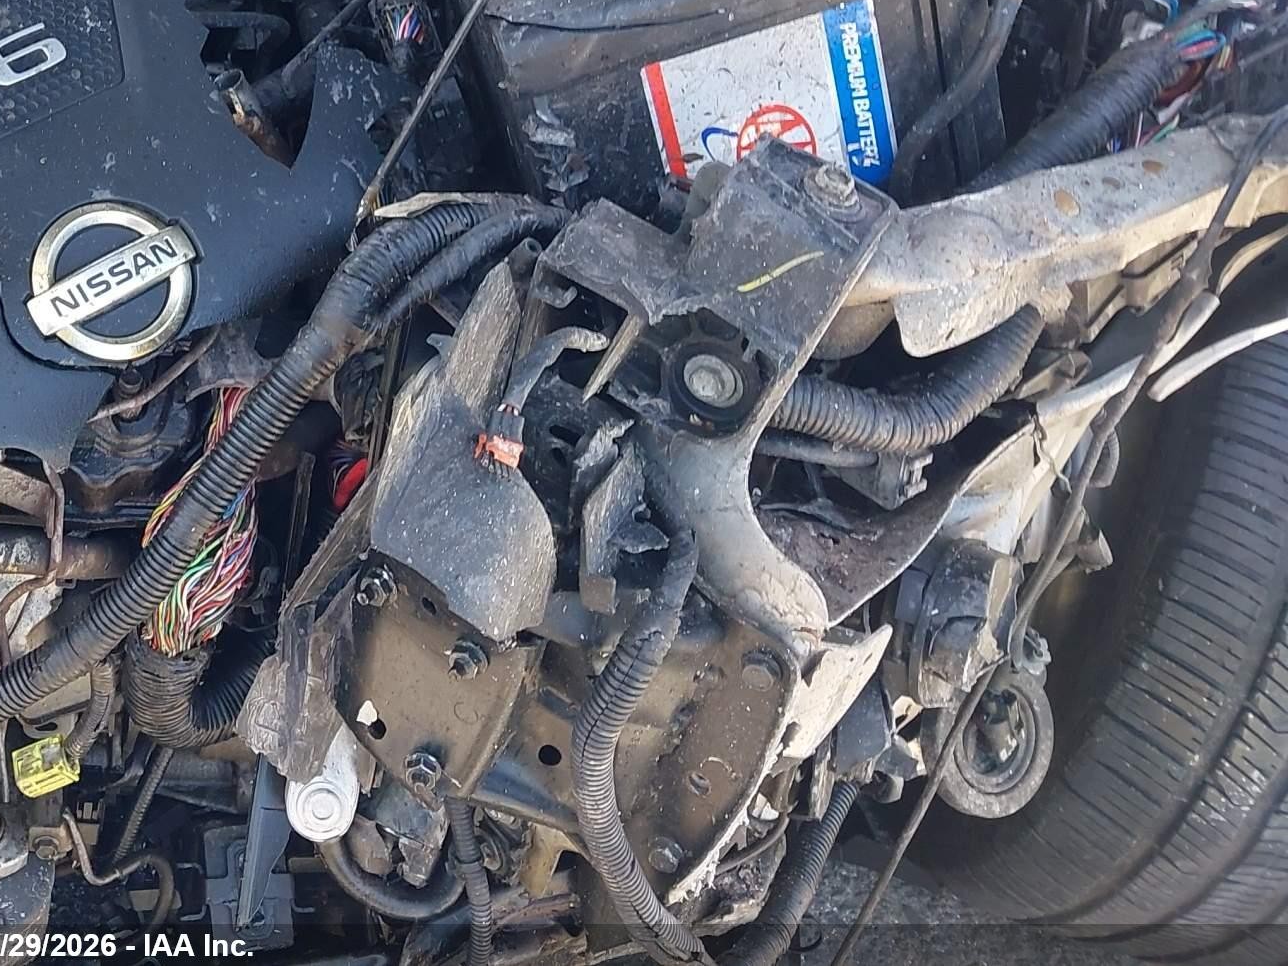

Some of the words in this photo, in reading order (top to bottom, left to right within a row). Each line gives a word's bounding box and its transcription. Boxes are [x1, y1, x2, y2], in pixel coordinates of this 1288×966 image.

[840, 22, 868, 97] PREMIUM
[853, 98, 880, 167] BATTERY
[50, 237, 178, 317] NISSAN
